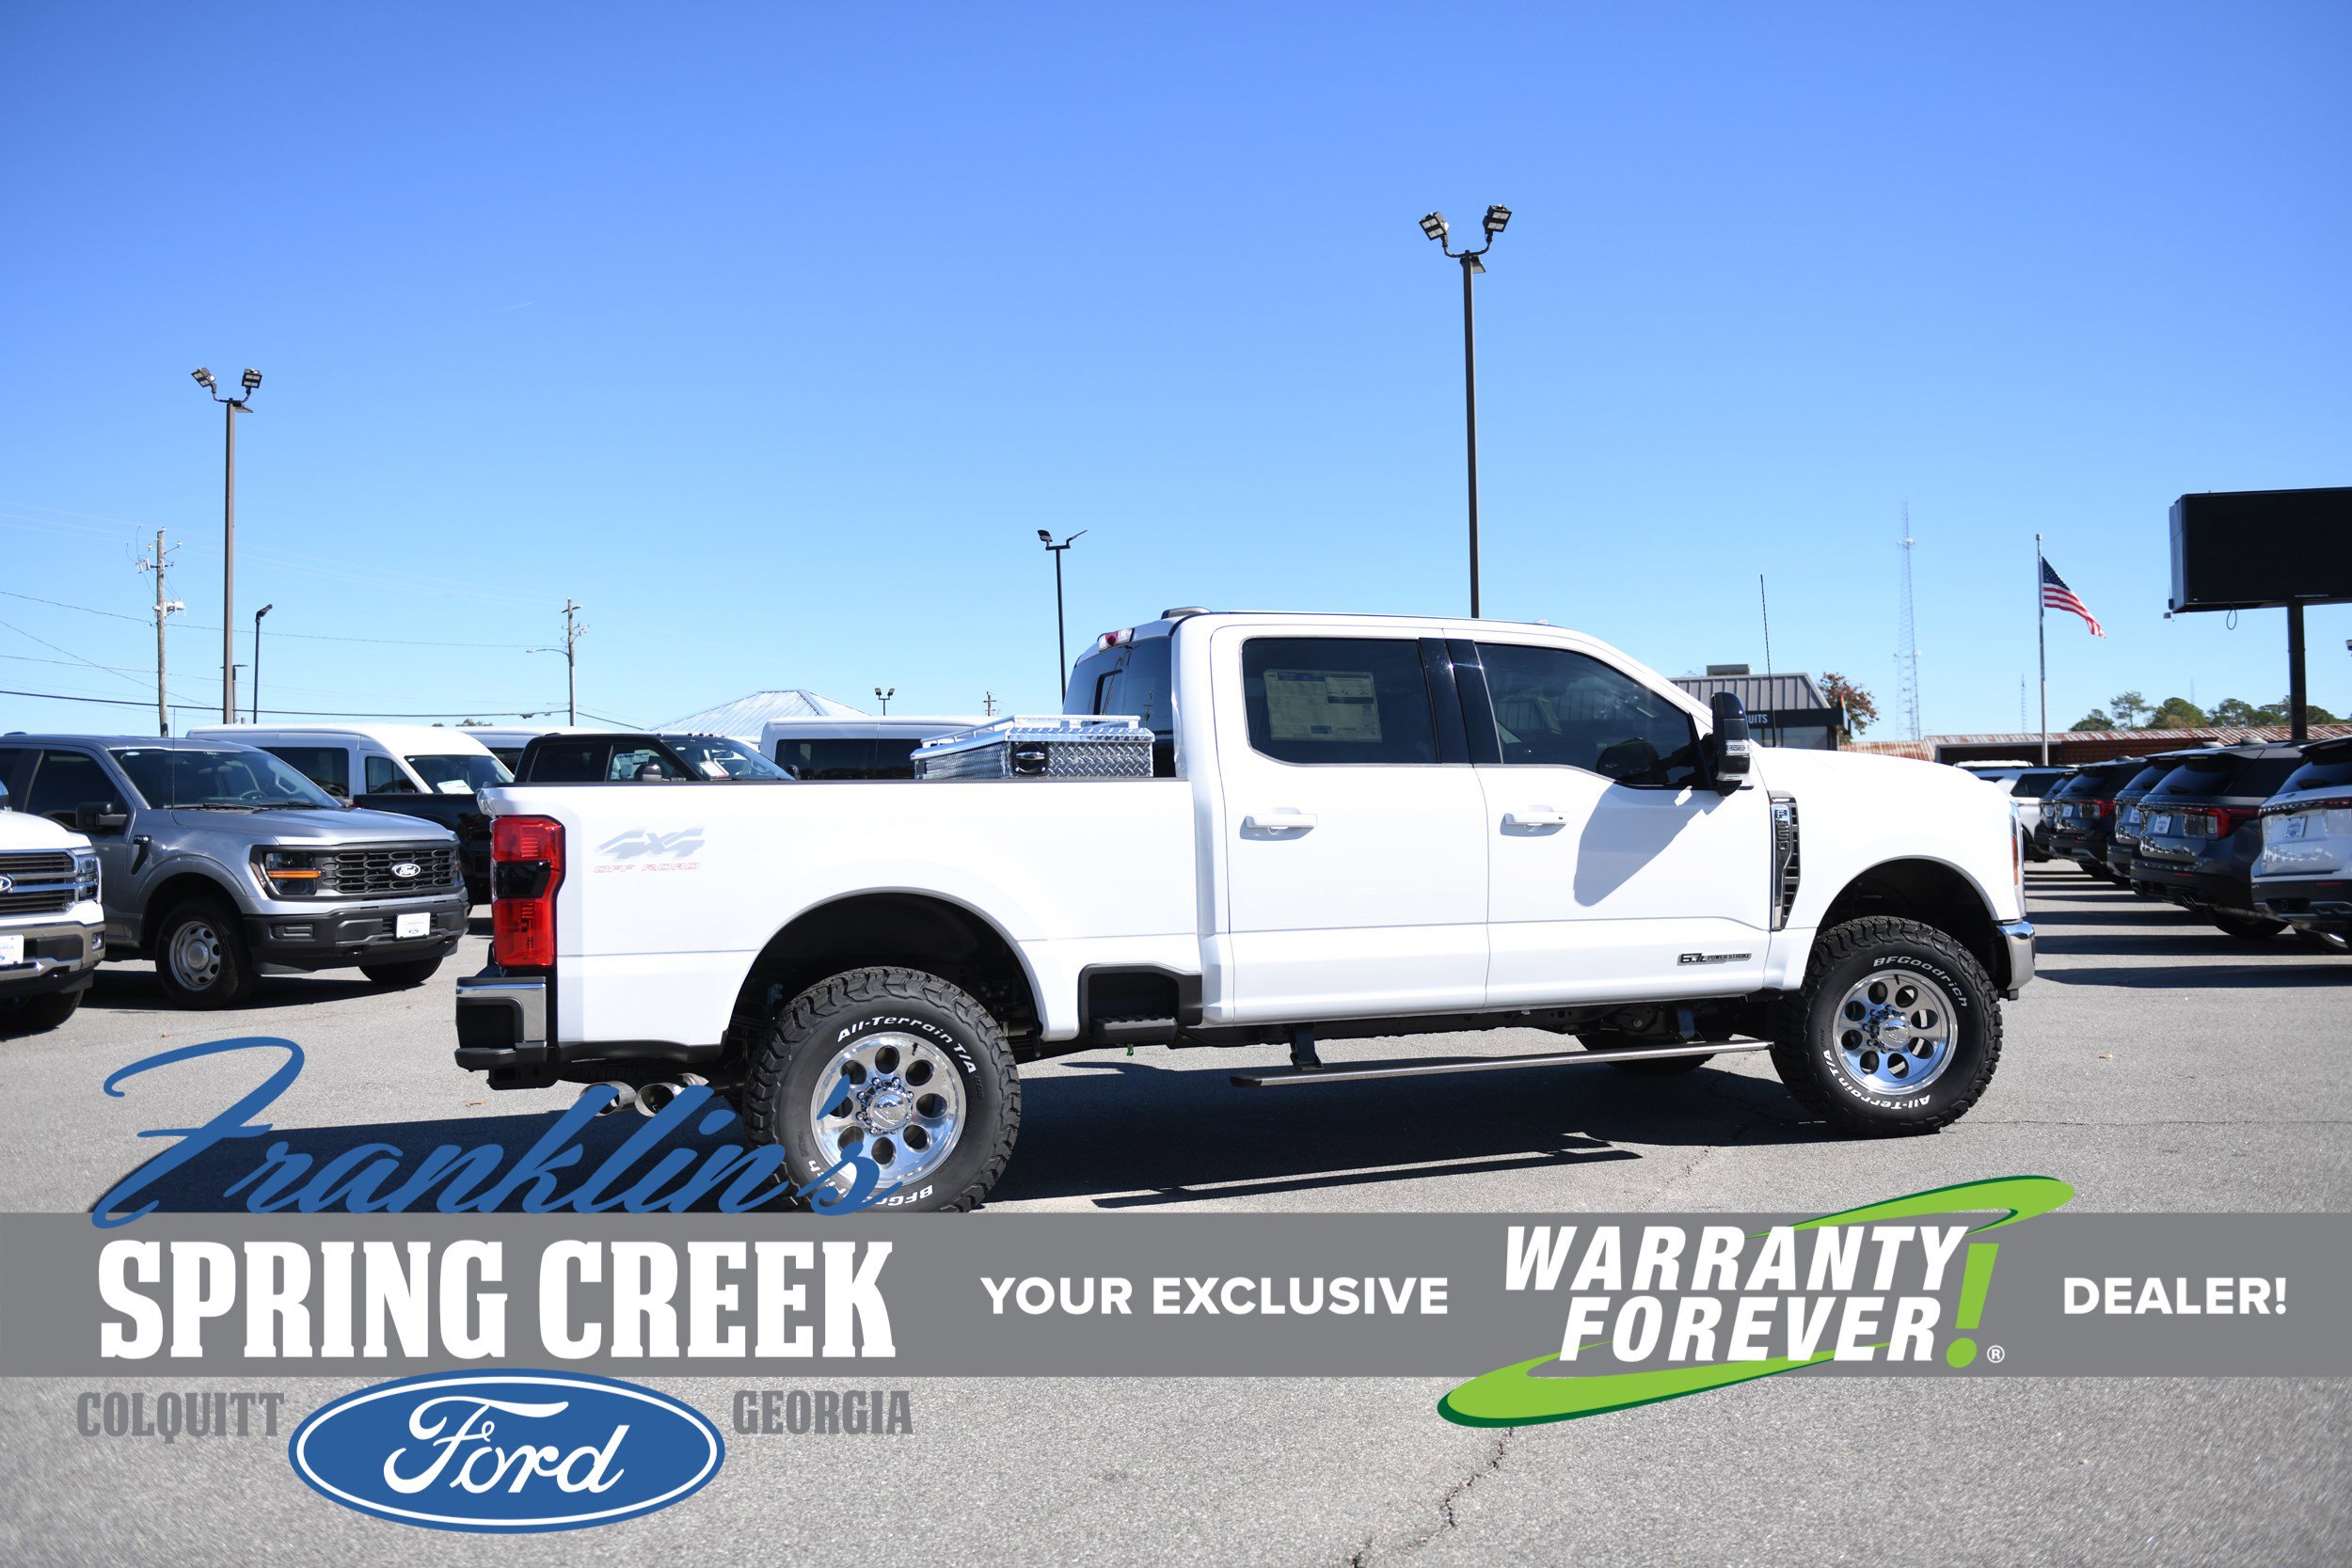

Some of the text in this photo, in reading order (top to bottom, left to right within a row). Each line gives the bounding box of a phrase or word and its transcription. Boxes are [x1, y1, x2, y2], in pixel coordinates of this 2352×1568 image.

[1747, 714, 1769, 724] UITS
[594, 862, 701, 874] OFF ROAD
[1872, 956, 1968, 1007] BFGoodrich
[837, 1015, 977, 1074] All-Terrain T/A
[1838, 1077, 1931, 1110] All-Terrain
